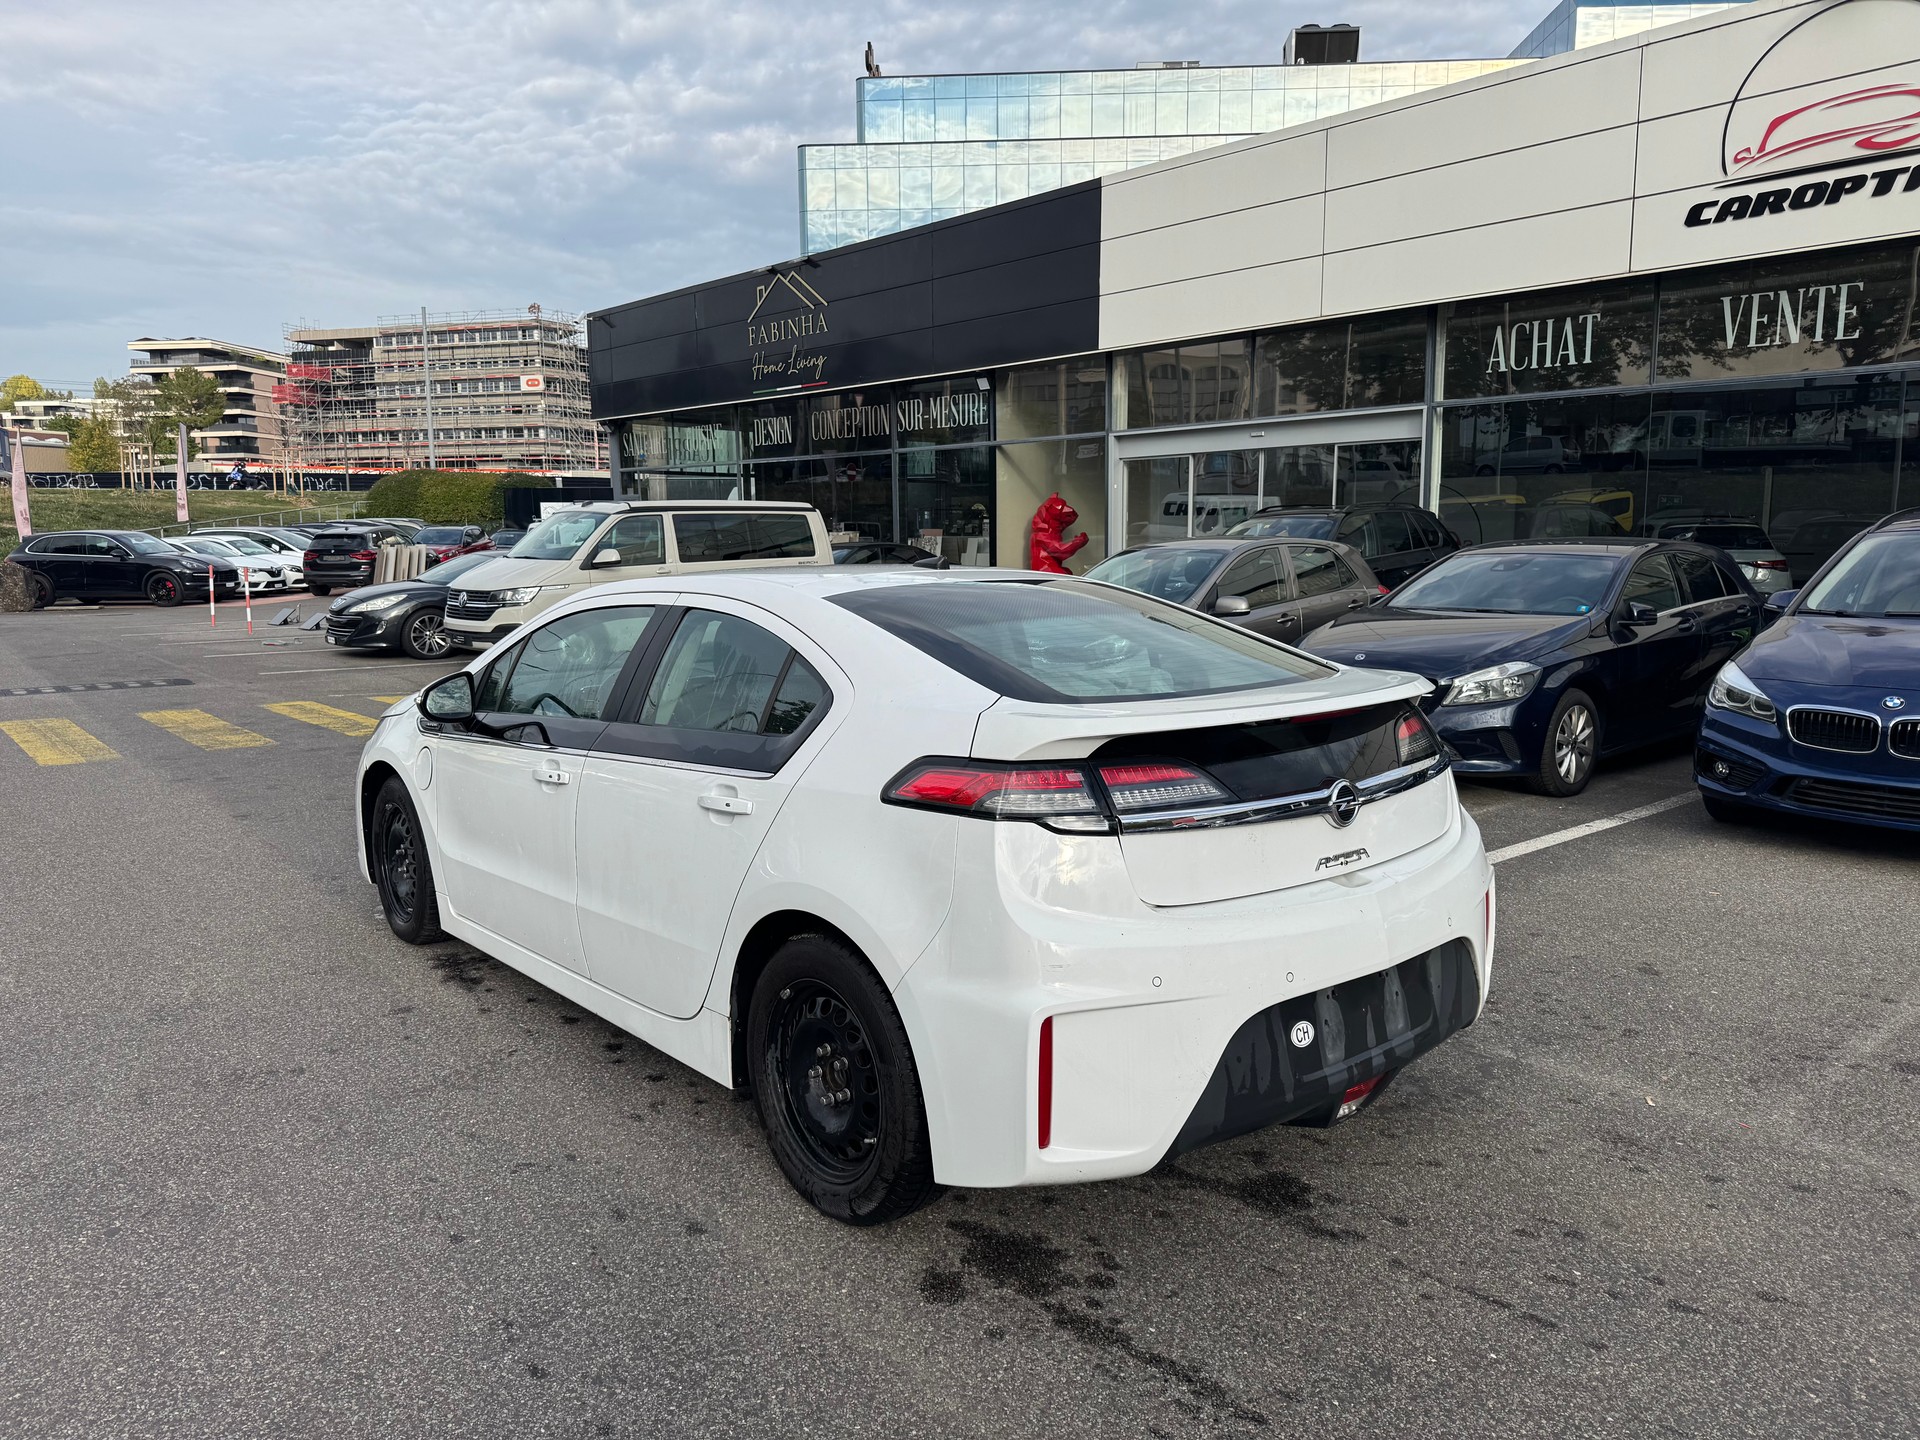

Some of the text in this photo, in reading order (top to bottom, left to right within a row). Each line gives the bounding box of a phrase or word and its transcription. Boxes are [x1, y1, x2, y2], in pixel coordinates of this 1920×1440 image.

[747, 311, 829, 347] FABINHA
[1720, 281, 1865, 350] VENTE
[1485, 312, 1601, 374] ACHAT
[752, 344, 828, 381] Home Living
[811, 403, 891, 441] CONCEPTION
[896, 391, 989, 433] SUR-MESURE
[685, 423, 724, 453] CUISINE
[753, 415, 793, 447] DESIGN
[1295, 1024, 1310, 1043] CH
